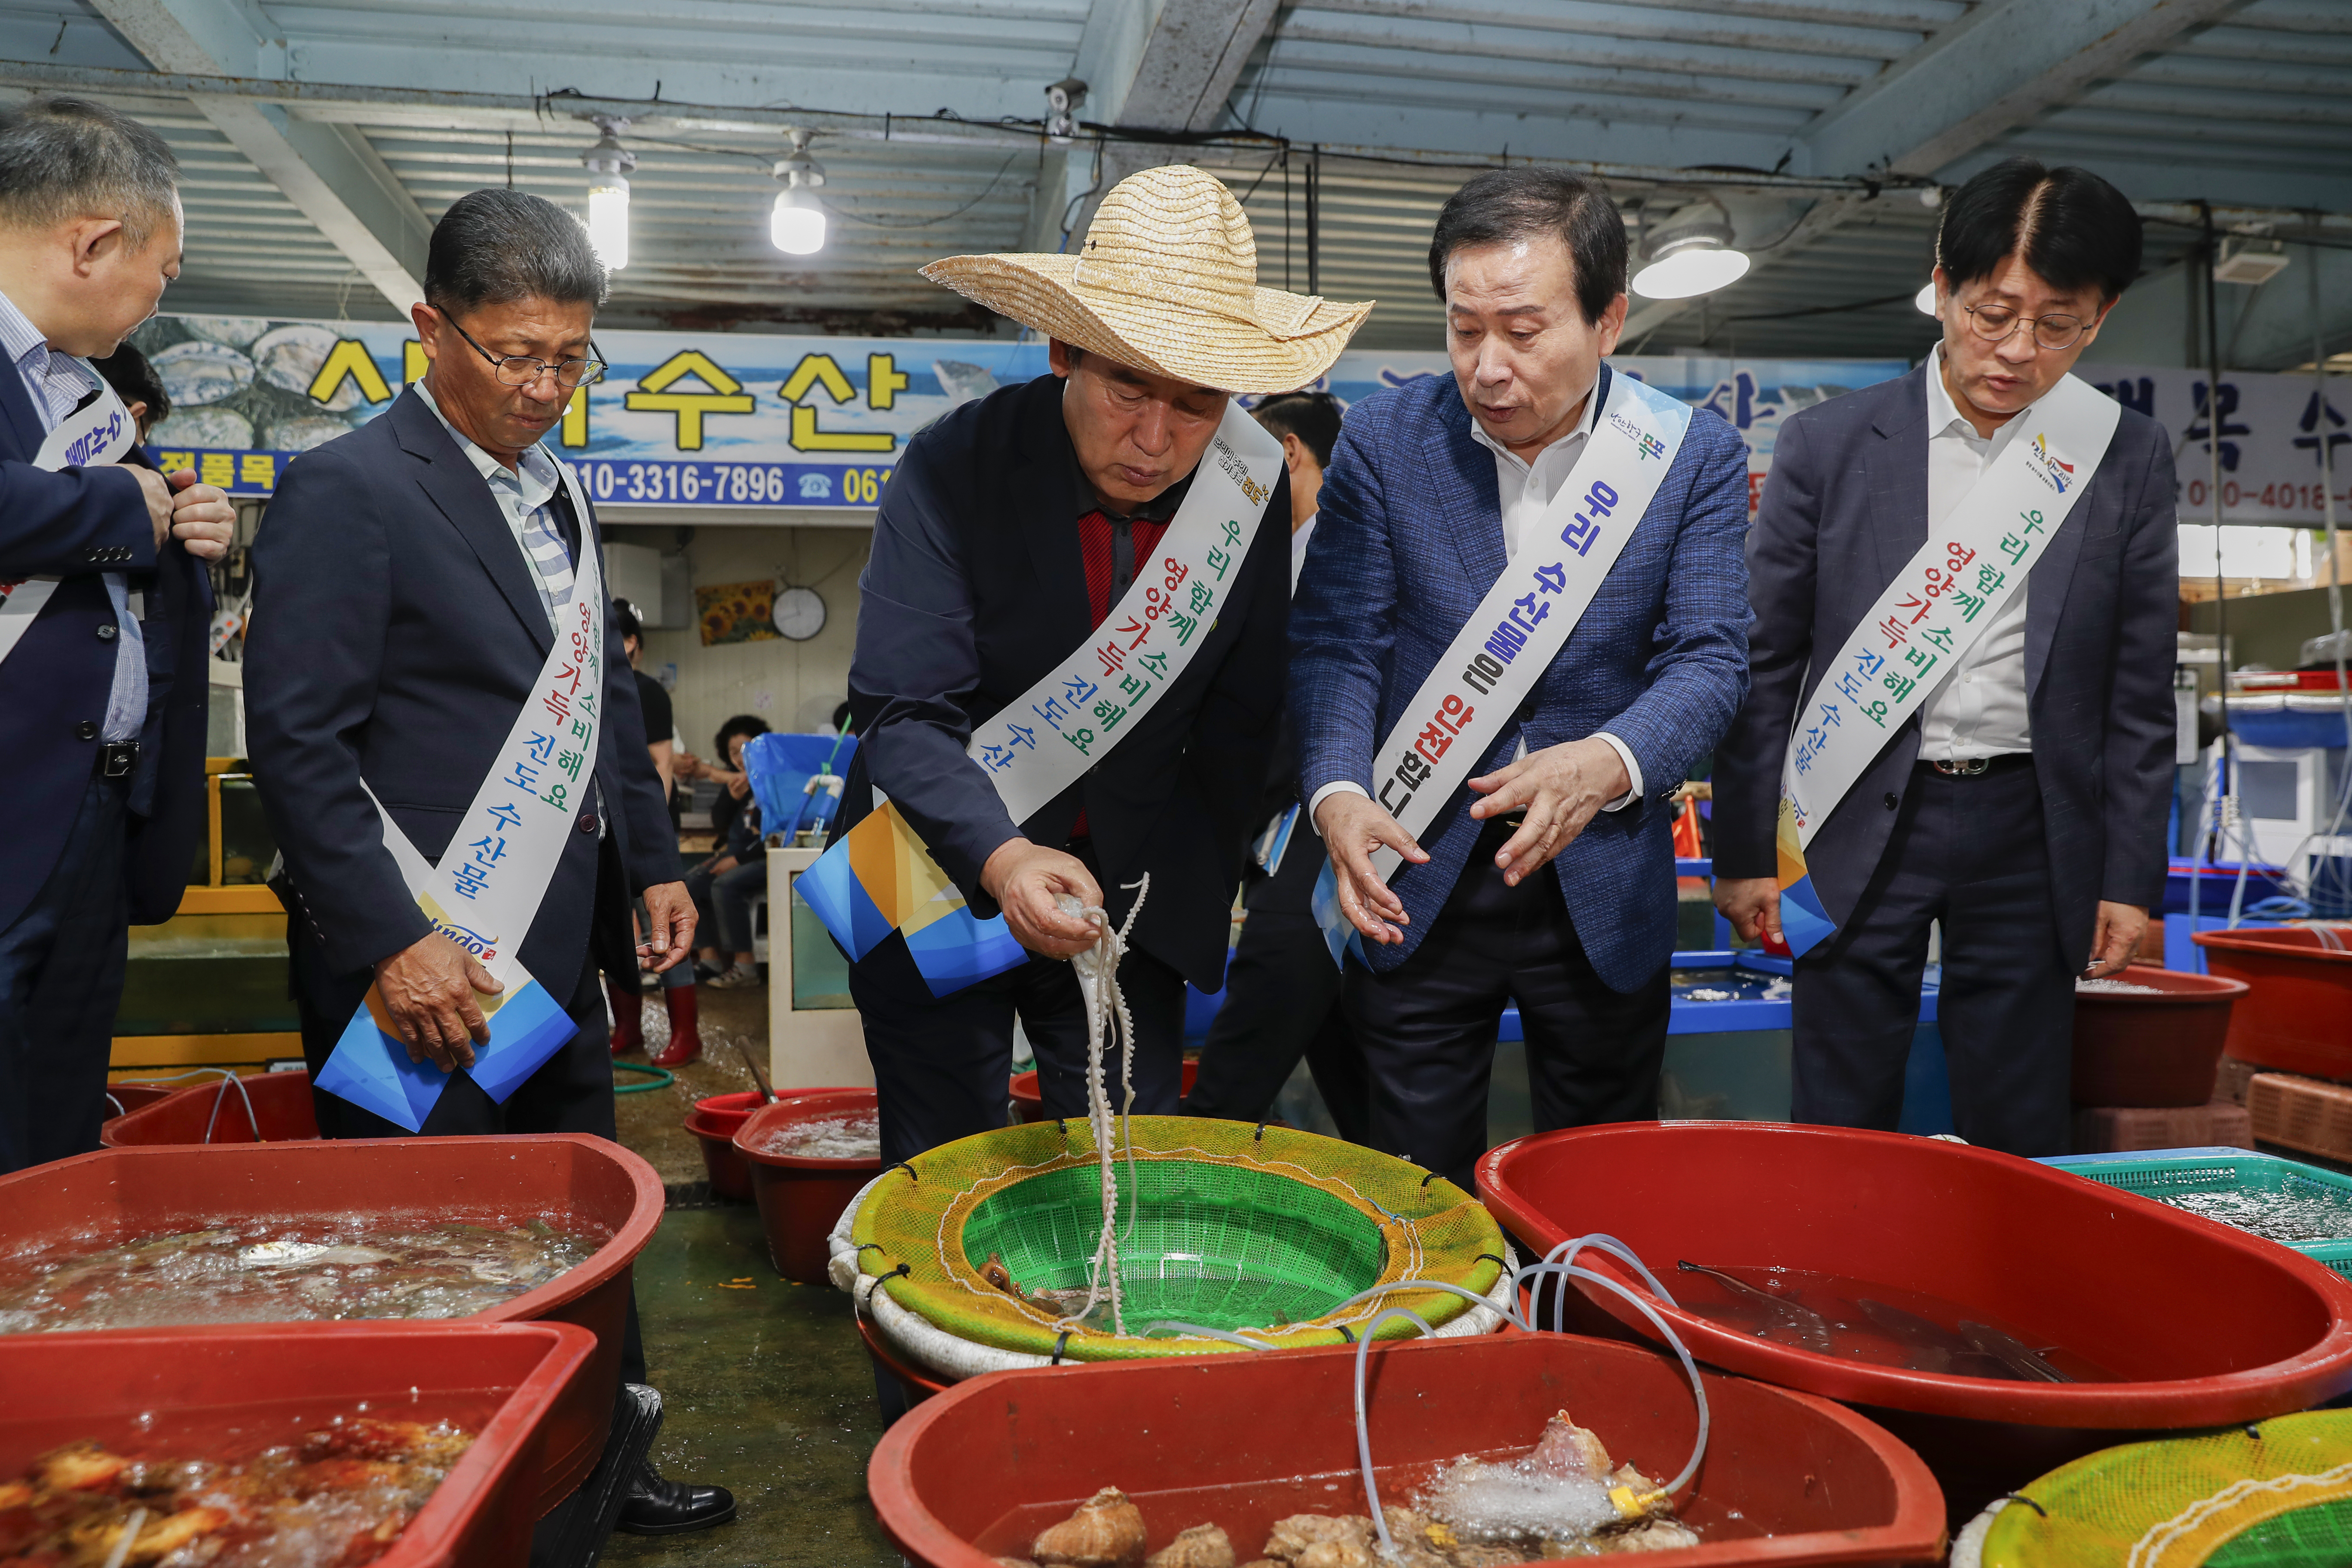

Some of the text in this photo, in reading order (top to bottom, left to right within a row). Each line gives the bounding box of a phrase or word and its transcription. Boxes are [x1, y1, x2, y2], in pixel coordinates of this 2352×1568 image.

[1638, 433, 1666, 460] 목포
[1242, 476, 1263, 506] 진도
[1560, 480, 1620, 558] 우리
[2188, 479, 2352, 511] 00-4018-
[1062, 519, 1242, 756] 우리 함께 소비해요
[1462, 561, 1567, 695] 수산물은
[1860, 509, 2045, 729] 우리 함께 소비해요
[540, 562, 601, 812] 우리 함께 소비해요
[1032, 674, 1099, 730] 진도
[1834, 647, 1885, 704] 진도
[503, 730, 555, 796] 진도
[971, 723, 1037, 775] 수산
[1795, 702, 1842, 776] 수산물
[452, 802, 521, 900] 수산물
